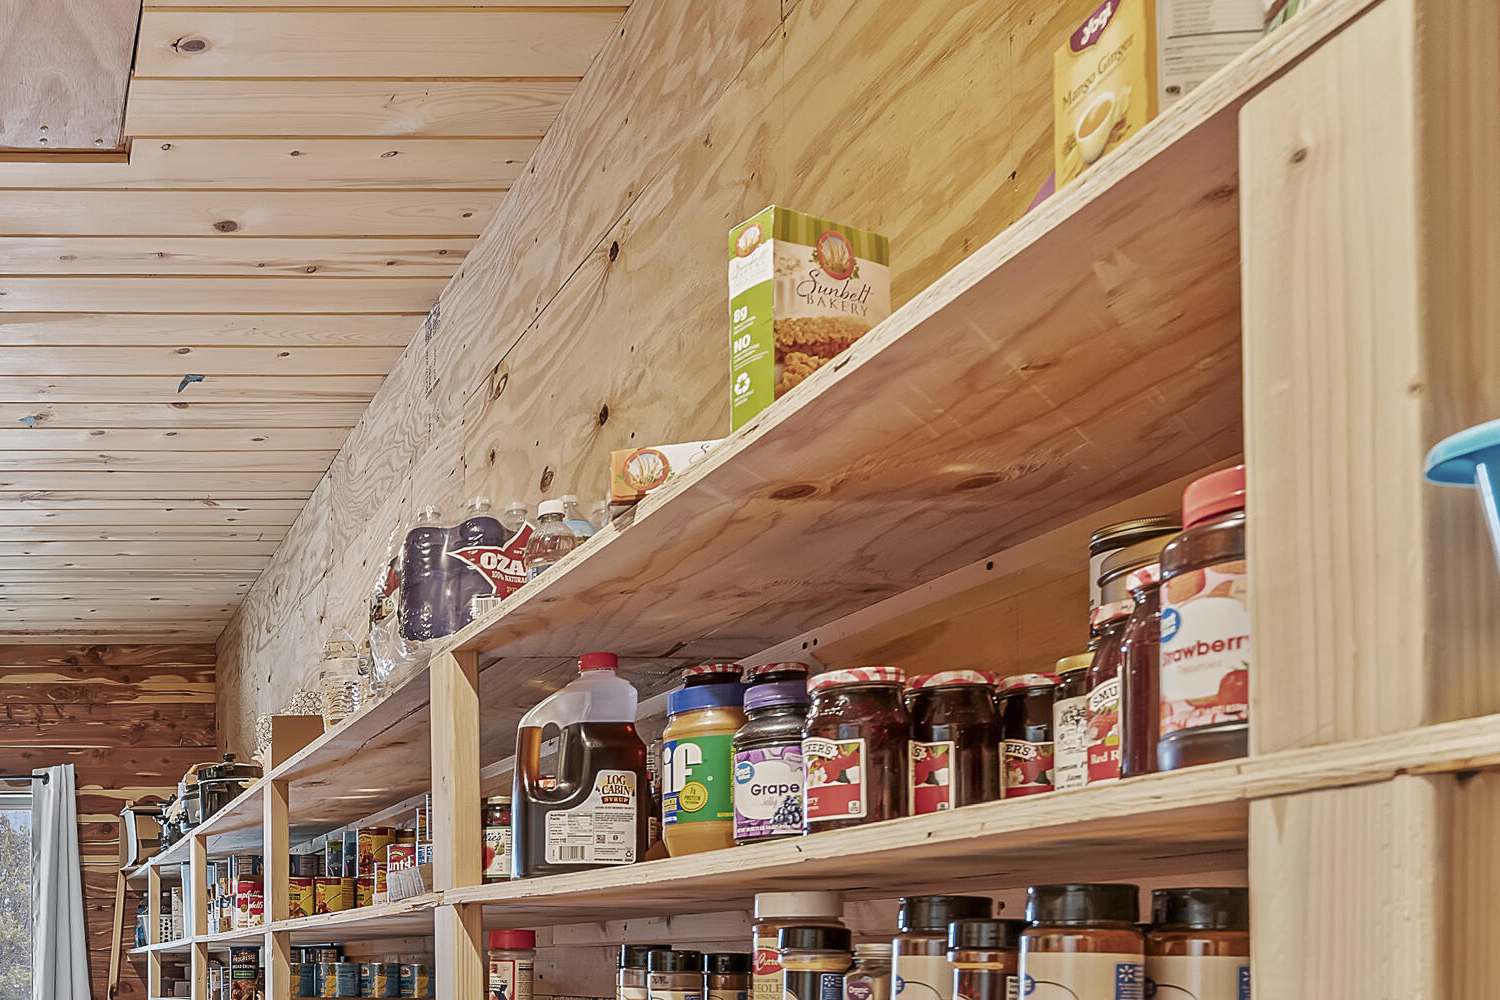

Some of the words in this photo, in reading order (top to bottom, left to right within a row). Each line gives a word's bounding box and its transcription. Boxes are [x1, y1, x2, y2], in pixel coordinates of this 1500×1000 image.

[1081, 1, 1113, 46] yogi
[1062, 70, 1096, 110] Mango
[1098, 35, 1134, 75] Ginger
[797, 269, 872, 304] Sunbelt
[806, 294, 869, 318] BAKERY
[733, 334, 751, 353] NO
[1090, 751, 1107, 764] Red
[606, 774, 626, 785] LOG
[601, 784, 631, 796] CABIN
[751, 783, 800, 797] Grape
